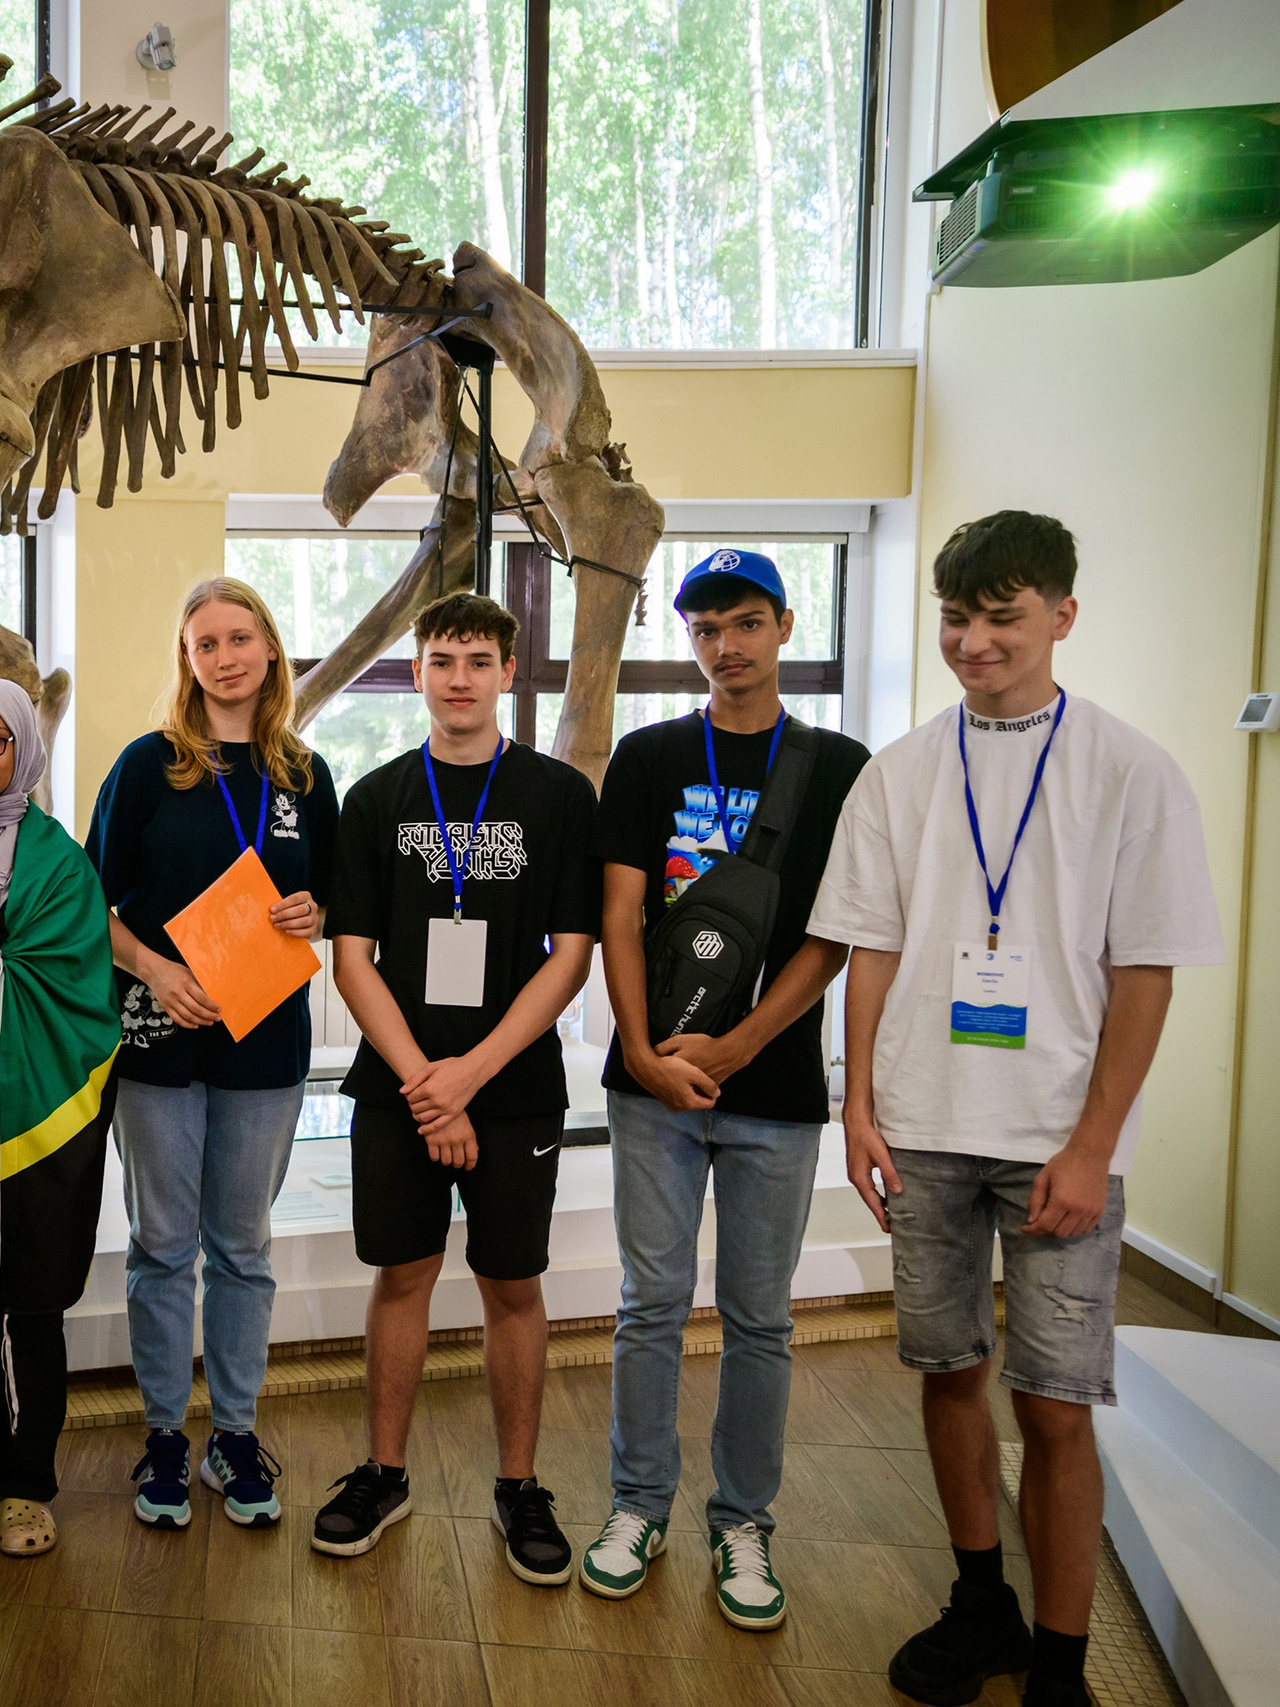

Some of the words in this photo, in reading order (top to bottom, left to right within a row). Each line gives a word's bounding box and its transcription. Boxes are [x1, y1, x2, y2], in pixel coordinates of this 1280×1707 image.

[968, 713, 991, 731] Los
[995, 709, 1051, 733] Angeles
[673, 810, 714, 840] WE
